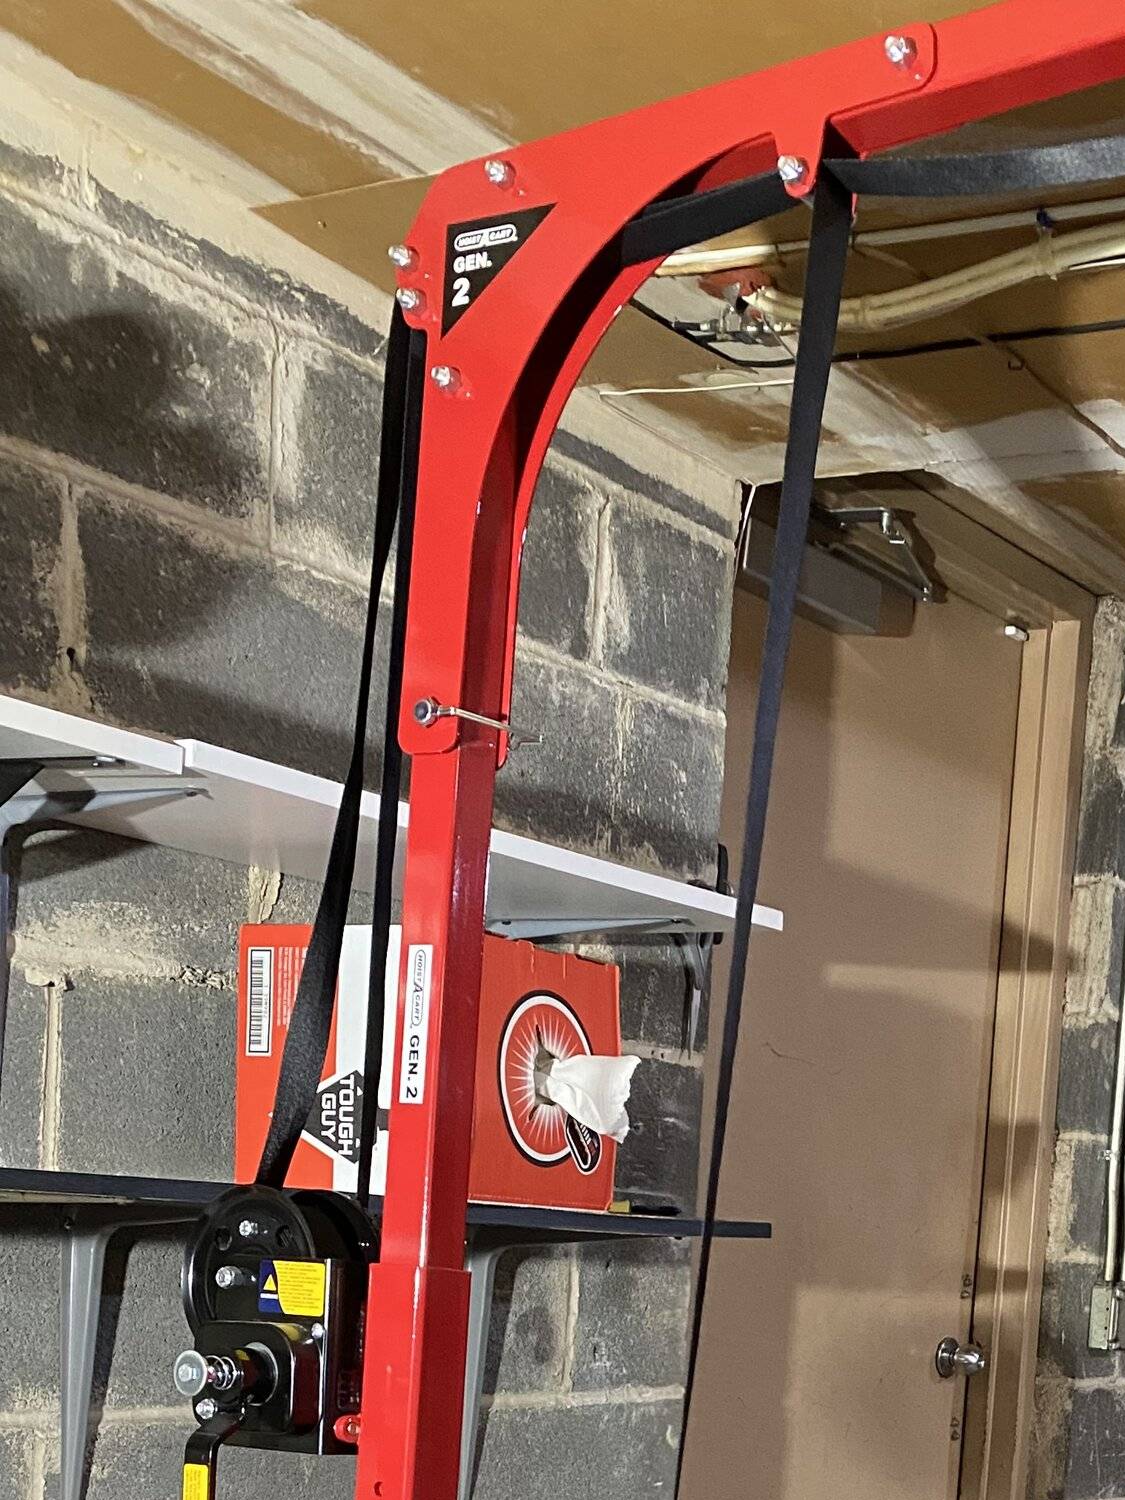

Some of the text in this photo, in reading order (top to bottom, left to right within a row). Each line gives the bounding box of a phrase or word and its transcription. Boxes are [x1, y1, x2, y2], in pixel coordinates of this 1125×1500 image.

[453, 251, 493, 274] GEN.
[451, 277, 470, 307] 2
[407, 1034, 420, 1081] GEN.
[406, 1086, 418, 1099] 2
[320, 1092, 337, 1143] GUY
[338, 1073, 355, 1156] TOUGH
